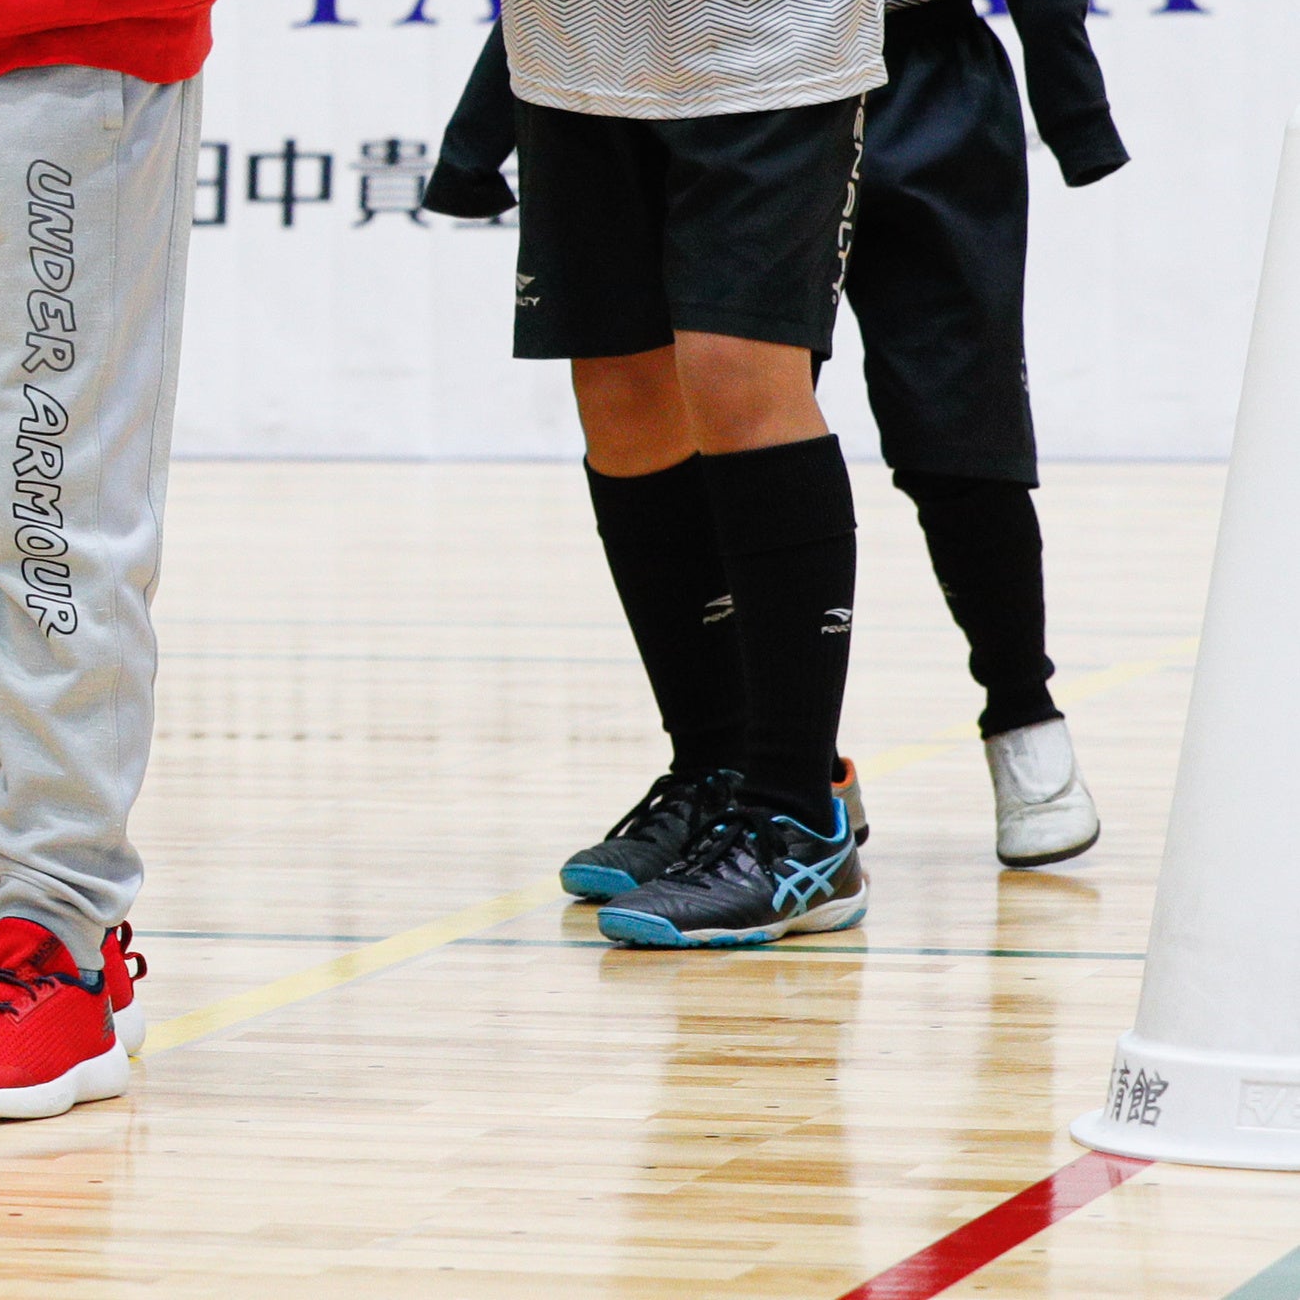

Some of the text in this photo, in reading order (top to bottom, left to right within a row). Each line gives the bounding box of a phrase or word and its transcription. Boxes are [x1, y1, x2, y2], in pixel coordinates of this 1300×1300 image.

[21, 158, 76, 374] UNDER
[831, 91, 867, 302] ENALTY
[12, 383, 78, 638] ARMOUR
